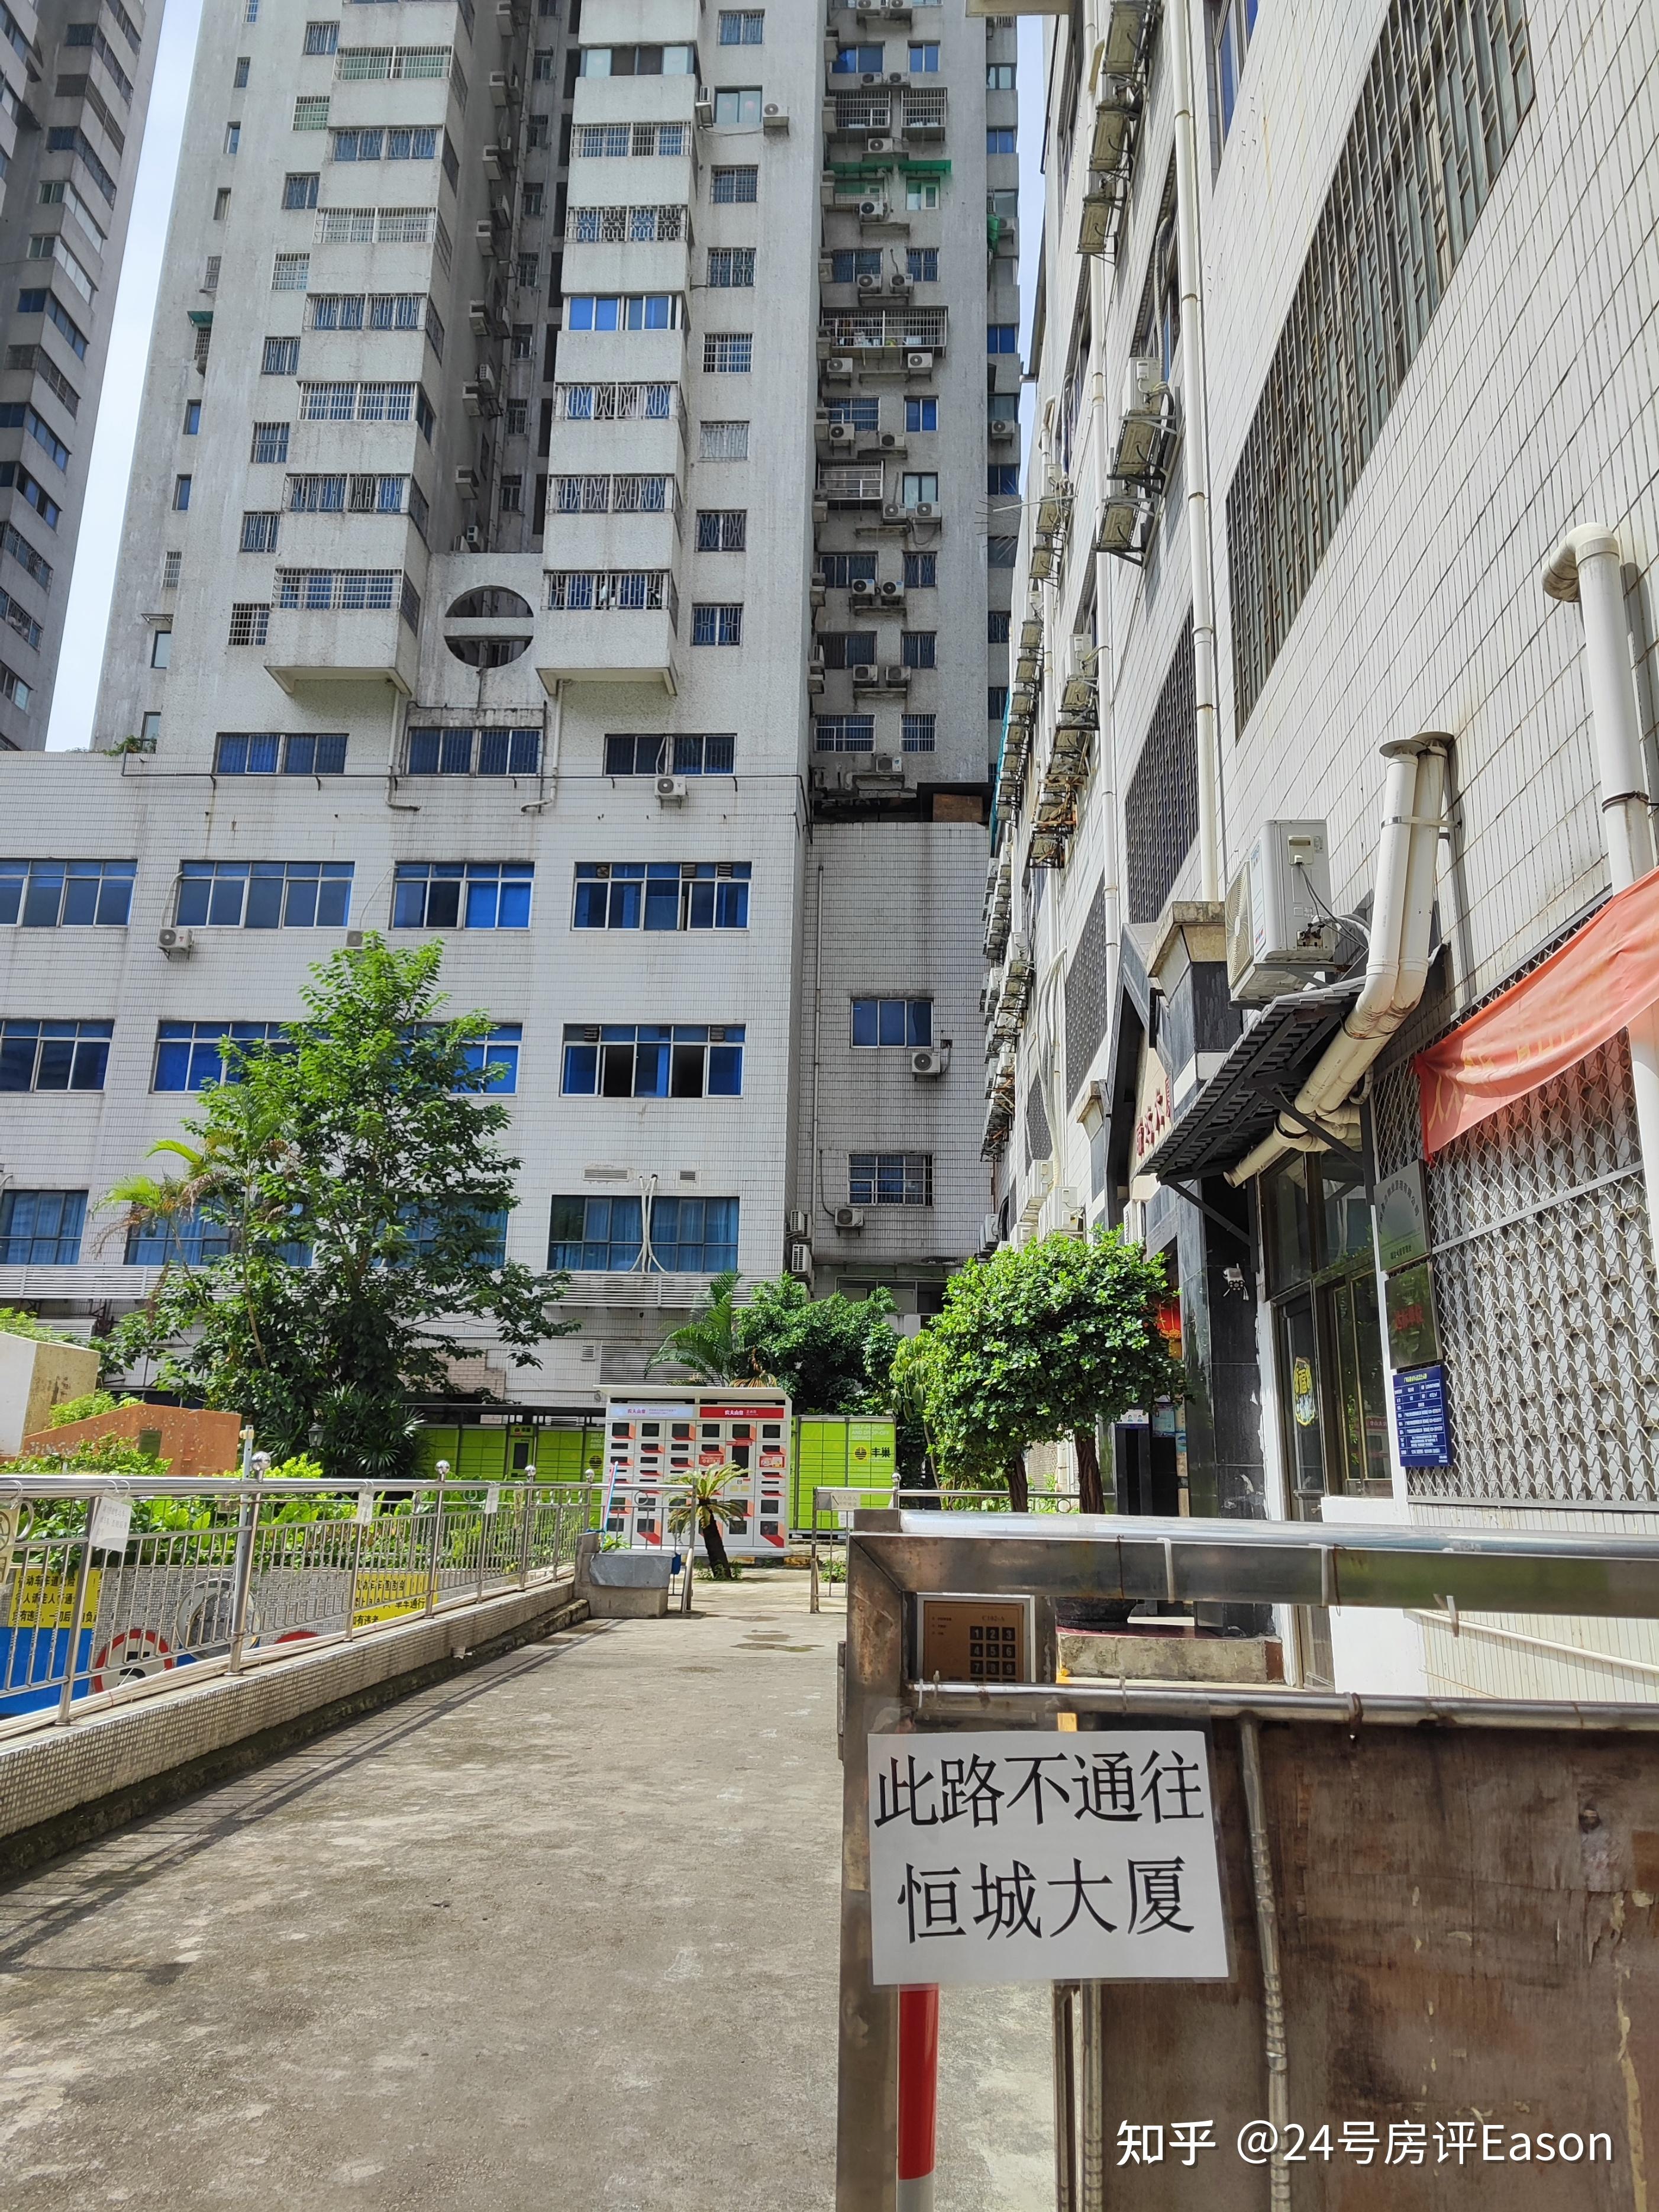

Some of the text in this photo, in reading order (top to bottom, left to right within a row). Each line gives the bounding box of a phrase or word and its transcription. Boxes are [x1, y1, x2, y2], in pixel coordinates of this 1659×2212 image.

[871, 1447, 891, 1458] 丰巢
[990, 1630, 996, 1639] 2
[1006, 1630, 1012, 1639] 3
[974, 1646, 1012, 1656] 4 5 6
[974, 1663, 1012, 1673] 7 8 9
[874, 1750, 1204, 1829] 此路不通往
[898, 1856, 1195, 1943] 恒城大厦
